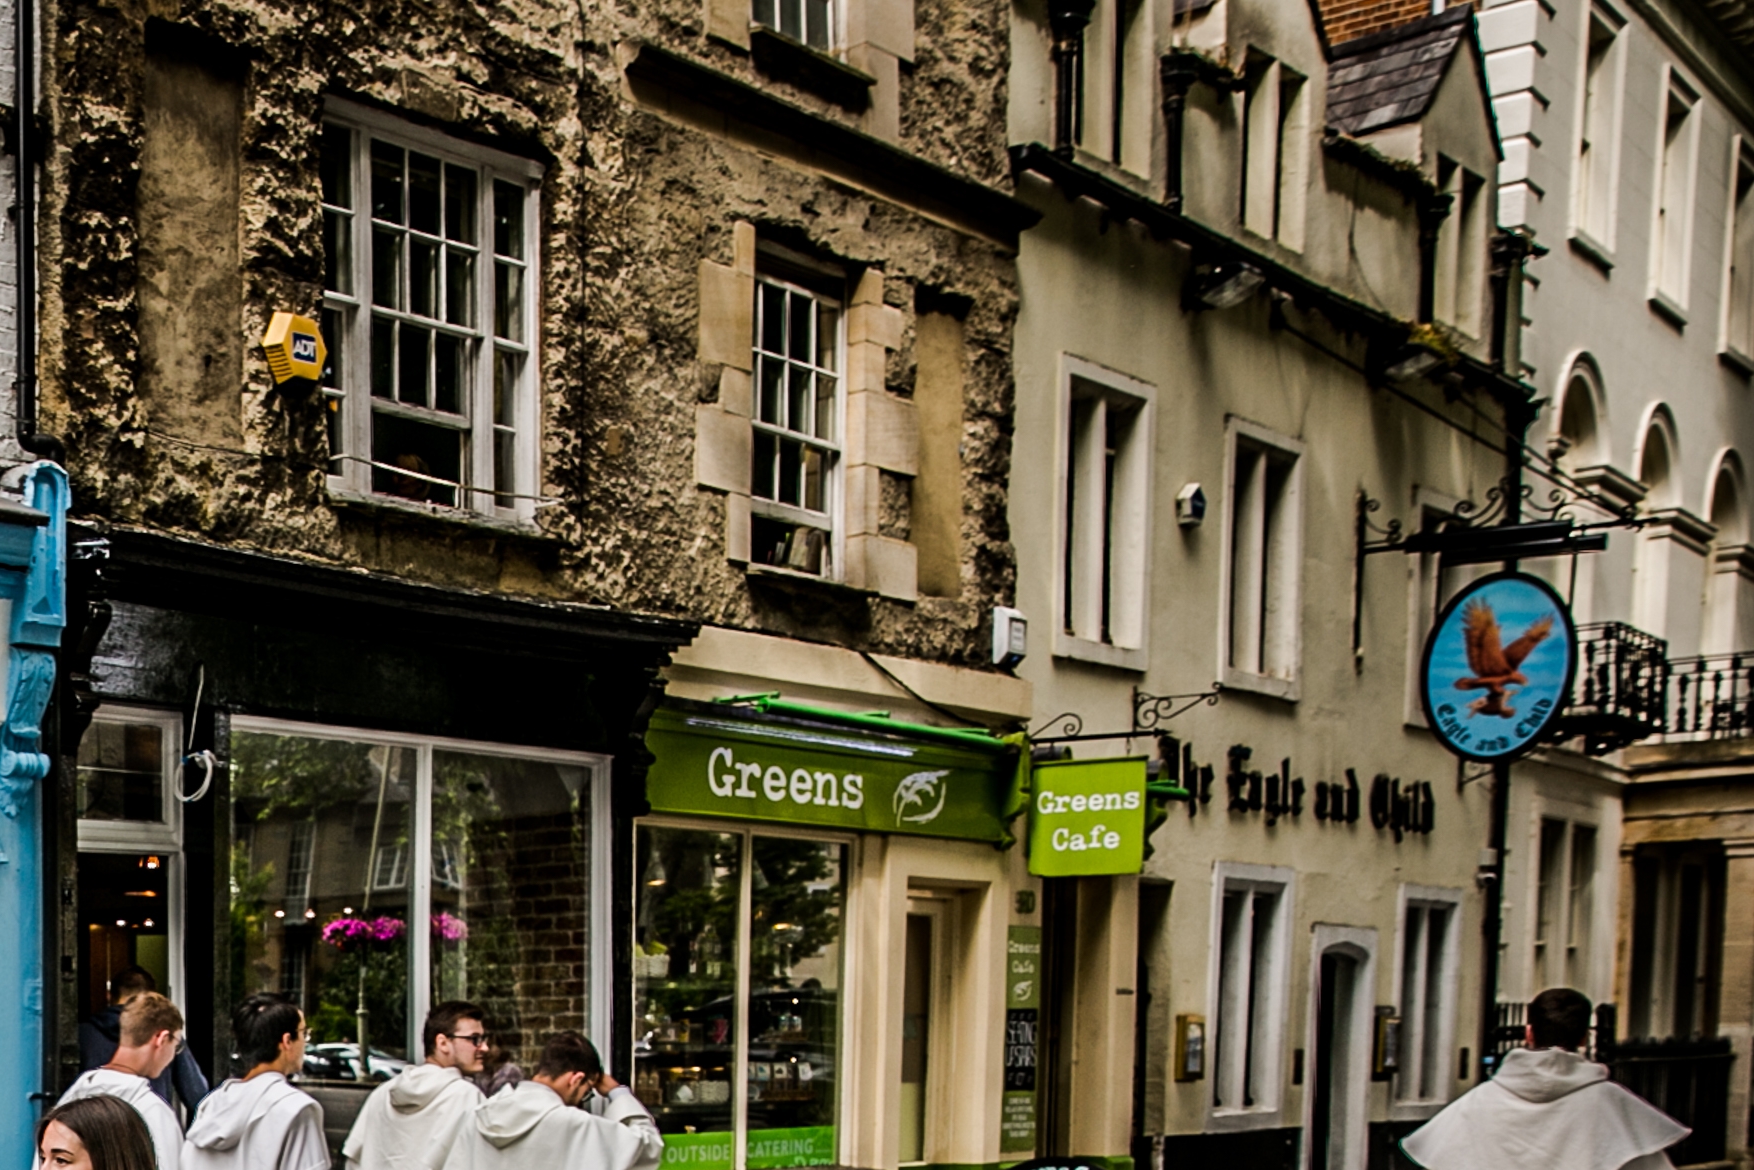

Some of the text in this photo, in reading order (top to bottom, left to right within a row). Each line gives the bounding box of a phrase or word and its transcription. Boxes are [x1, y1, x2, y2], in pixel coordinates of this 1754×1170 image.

[294, 339, 316, 357] ADT
[1436, 703, 1472, 744] Eagle
[1475, 735, 1510, 752] and
[707, 746, 864, 820] Greens
[1226, 743, 1306, 827] Eagle
[1314, 767, 1360, 824] and
[1037, 790, 1140, 814] Greens
[1052, 824, 1120, 852] Cafe
[666, 1138, 814, 1164] OUTSIDE CATERING
